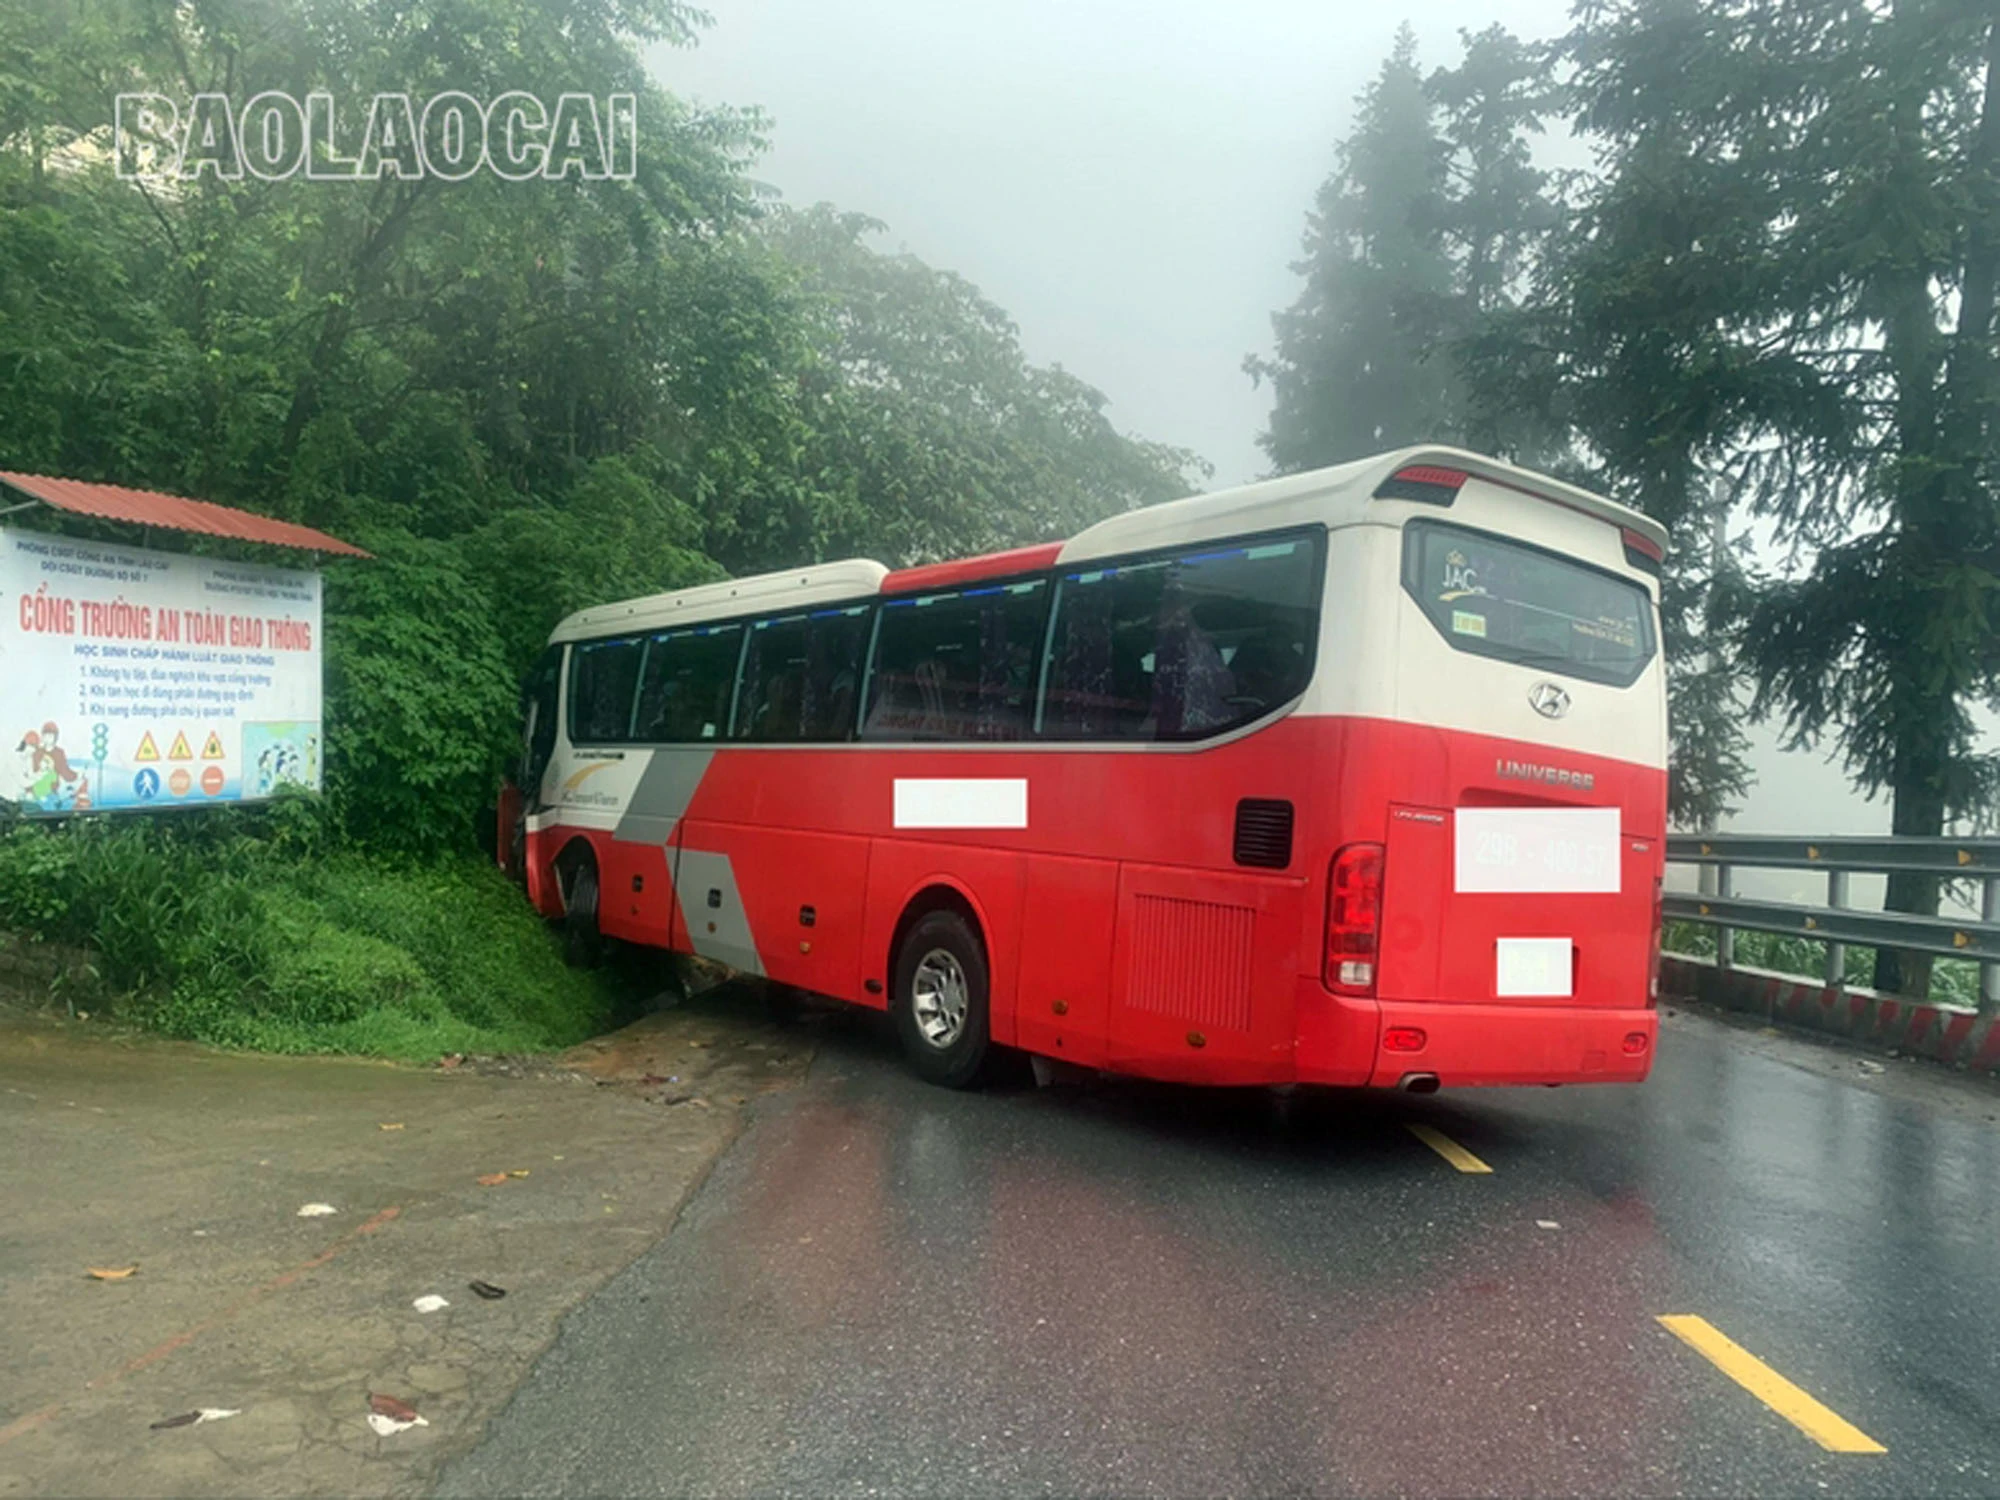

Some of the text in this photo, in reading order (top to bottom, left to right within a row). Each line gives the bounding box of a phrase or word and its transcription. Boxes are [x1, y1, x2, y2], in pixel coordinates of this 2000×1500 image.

[20, 580, 311, 651] CỔNG TRƯỜNG AN TOÀN GIAO THÔNG
[74, 643, 99, 658] HỌC
[102, 644, 129, 657] SINH
[220, 653, 243, 665] GIAO
[245, 652, 275, 666] THÔNG
[90, 684, 105, 697] Khi
[90, 703, 105, 715] Khi
[1495, 758, 1595, 791] UNIVERSE
